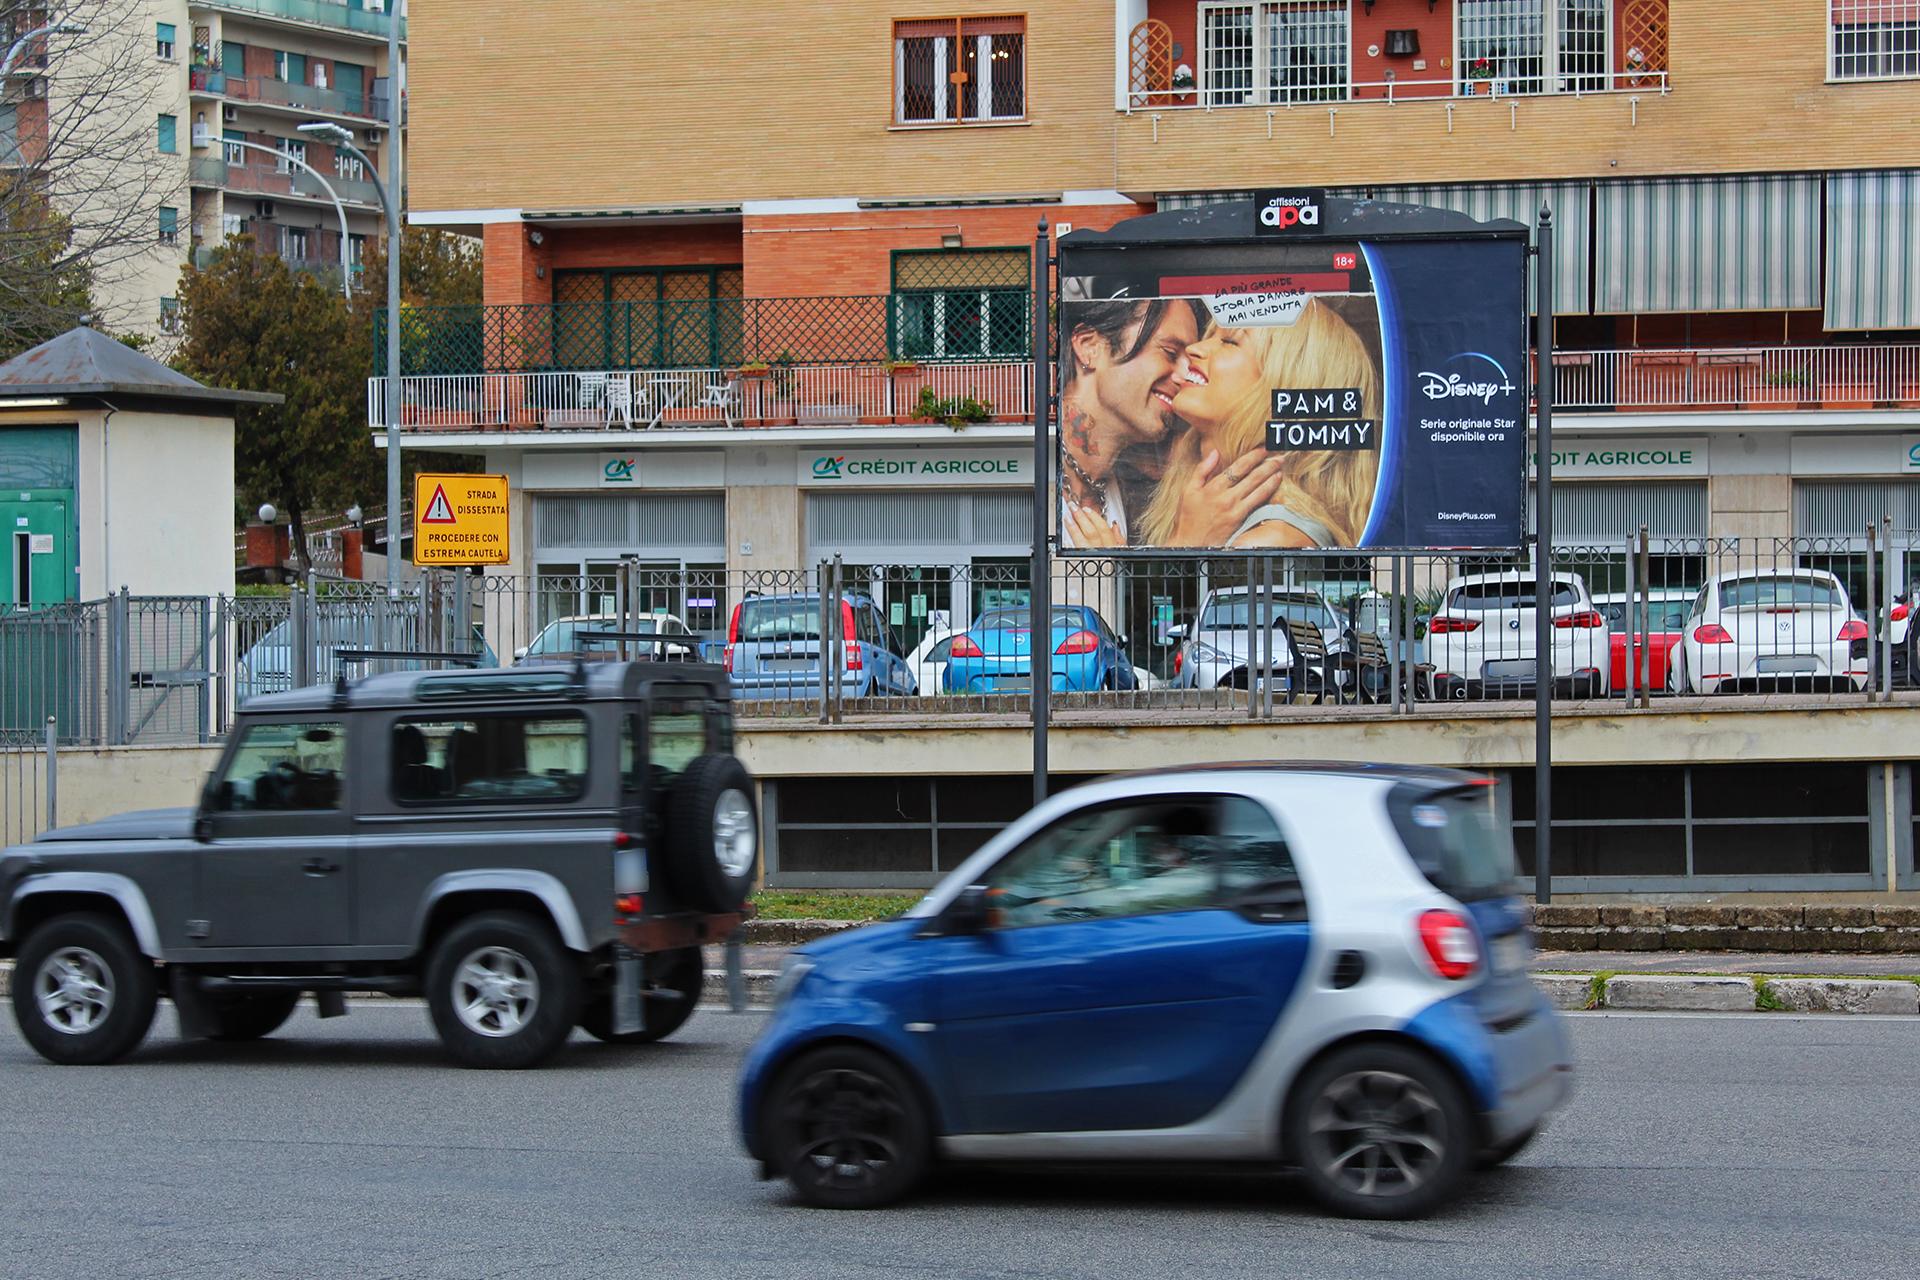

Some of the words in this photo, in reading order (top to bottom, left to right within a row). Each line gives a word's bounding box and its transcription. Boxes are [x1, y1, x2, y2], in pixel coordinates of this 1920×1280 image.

[1269, 196, 1310, 206] affissioni
[1260, 205, 1318, 229] apa
[1335, 256, 1353, 266] 18+
[1214, 287, 1228, 298] LA
[1250, 277, 1293, 291] GRANDE
[1213, 296, 1255, 314] STORIA
[1228, 310, 1247, 323] MAI
[1250, 300, 1302, 318] VENDUTA
[1277, 392, 1334, 414] PAM
[1342, 391, 1357, 412] &
[1420, 419, 1447, 428] Serie
[1448, 419, 1492, 430] originale
[1494, 418, 1516, 428] Star
[1270, 422, 1370, 445] TOMMY
[1430, 431, 1485, 442] disponibile
[1487, 433, 1505, 441] ora
[1584, 450, 1692, 465] AGRICOLE
[847, 459, 917, 475] CRÉDIT
[920, 460, 1019, 474] AGRICOLE
[467, 490, 497, 500] STRADA
[457, 505, 506, 515] DISSESTATA
[1437, 512, 1496, 521] DisneyPlus.com
[428, 533, 480, 543] PROCEDERE
[482, 533, 499, 543] CON
[424, 548, 466, 558] ESTREMA
[468, 548, 504, 558] CAUTELA
